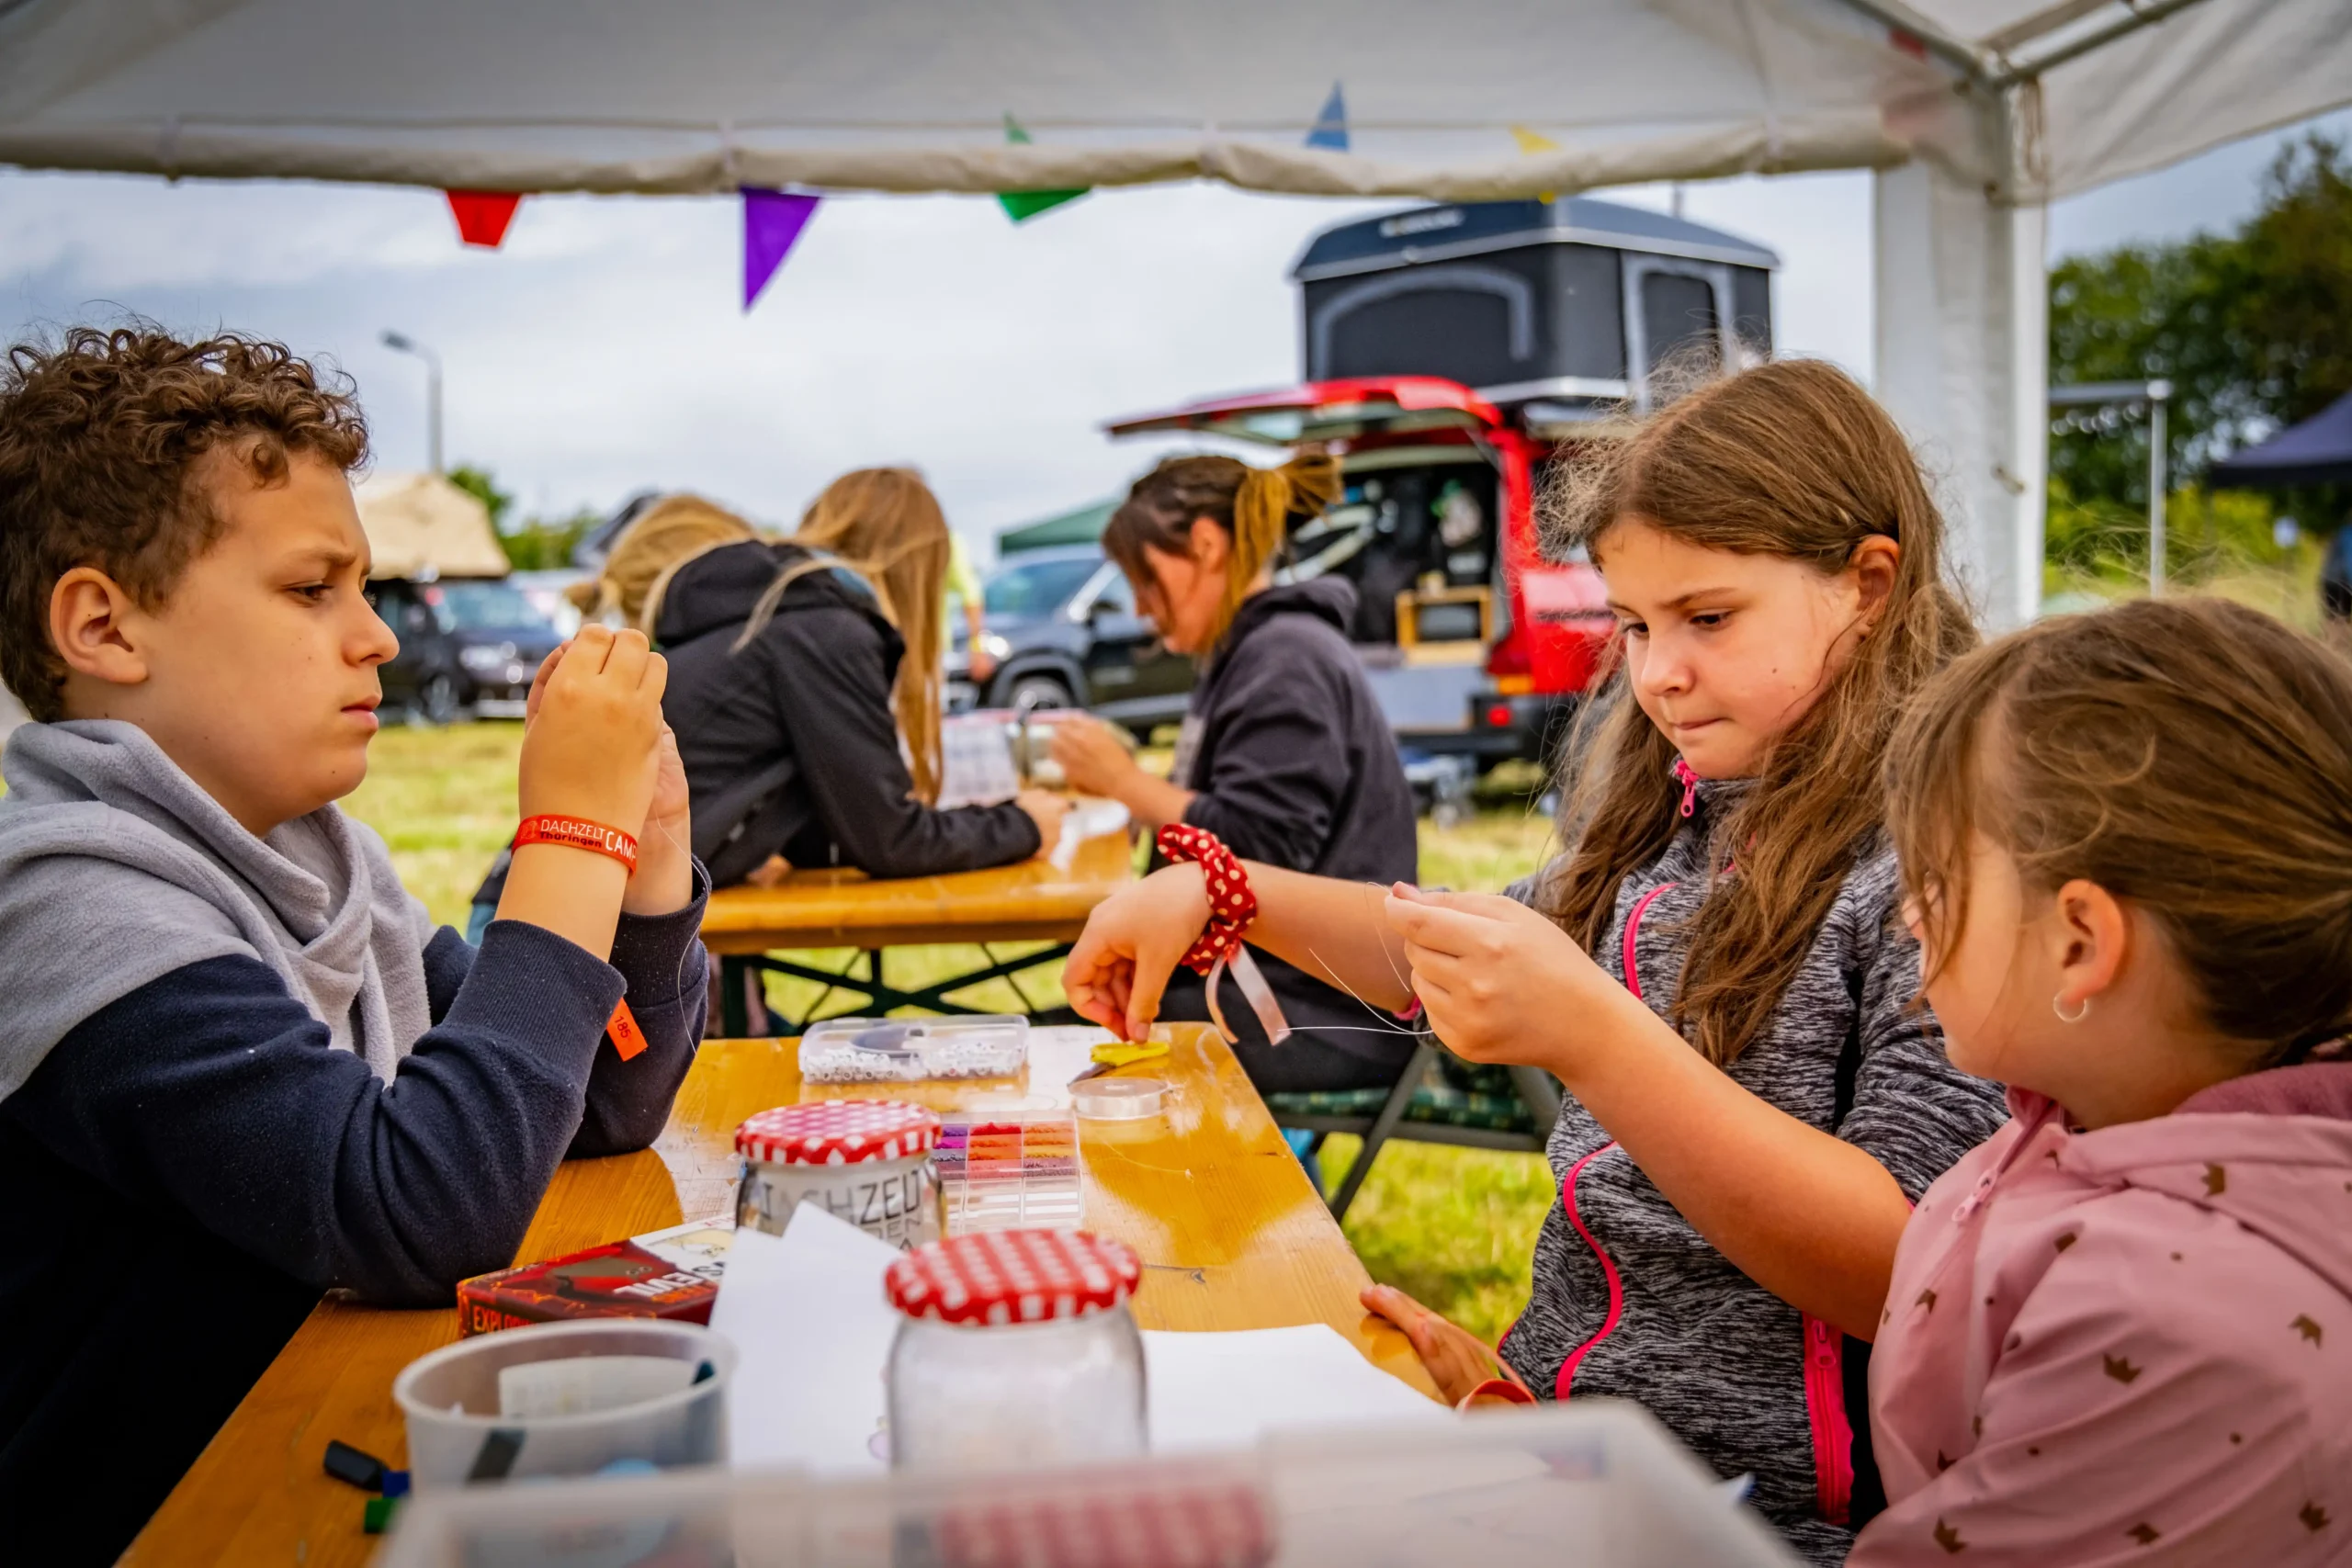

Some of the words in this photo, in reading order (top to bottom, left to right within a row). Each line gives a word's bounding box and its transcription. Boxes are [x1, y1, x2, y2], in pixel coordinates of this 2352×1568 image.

[540, 819, 605, 840] DACHZELT
[615, 1016, 631, 1038] 185
[761, 1168, 922, 1226] HZELT
